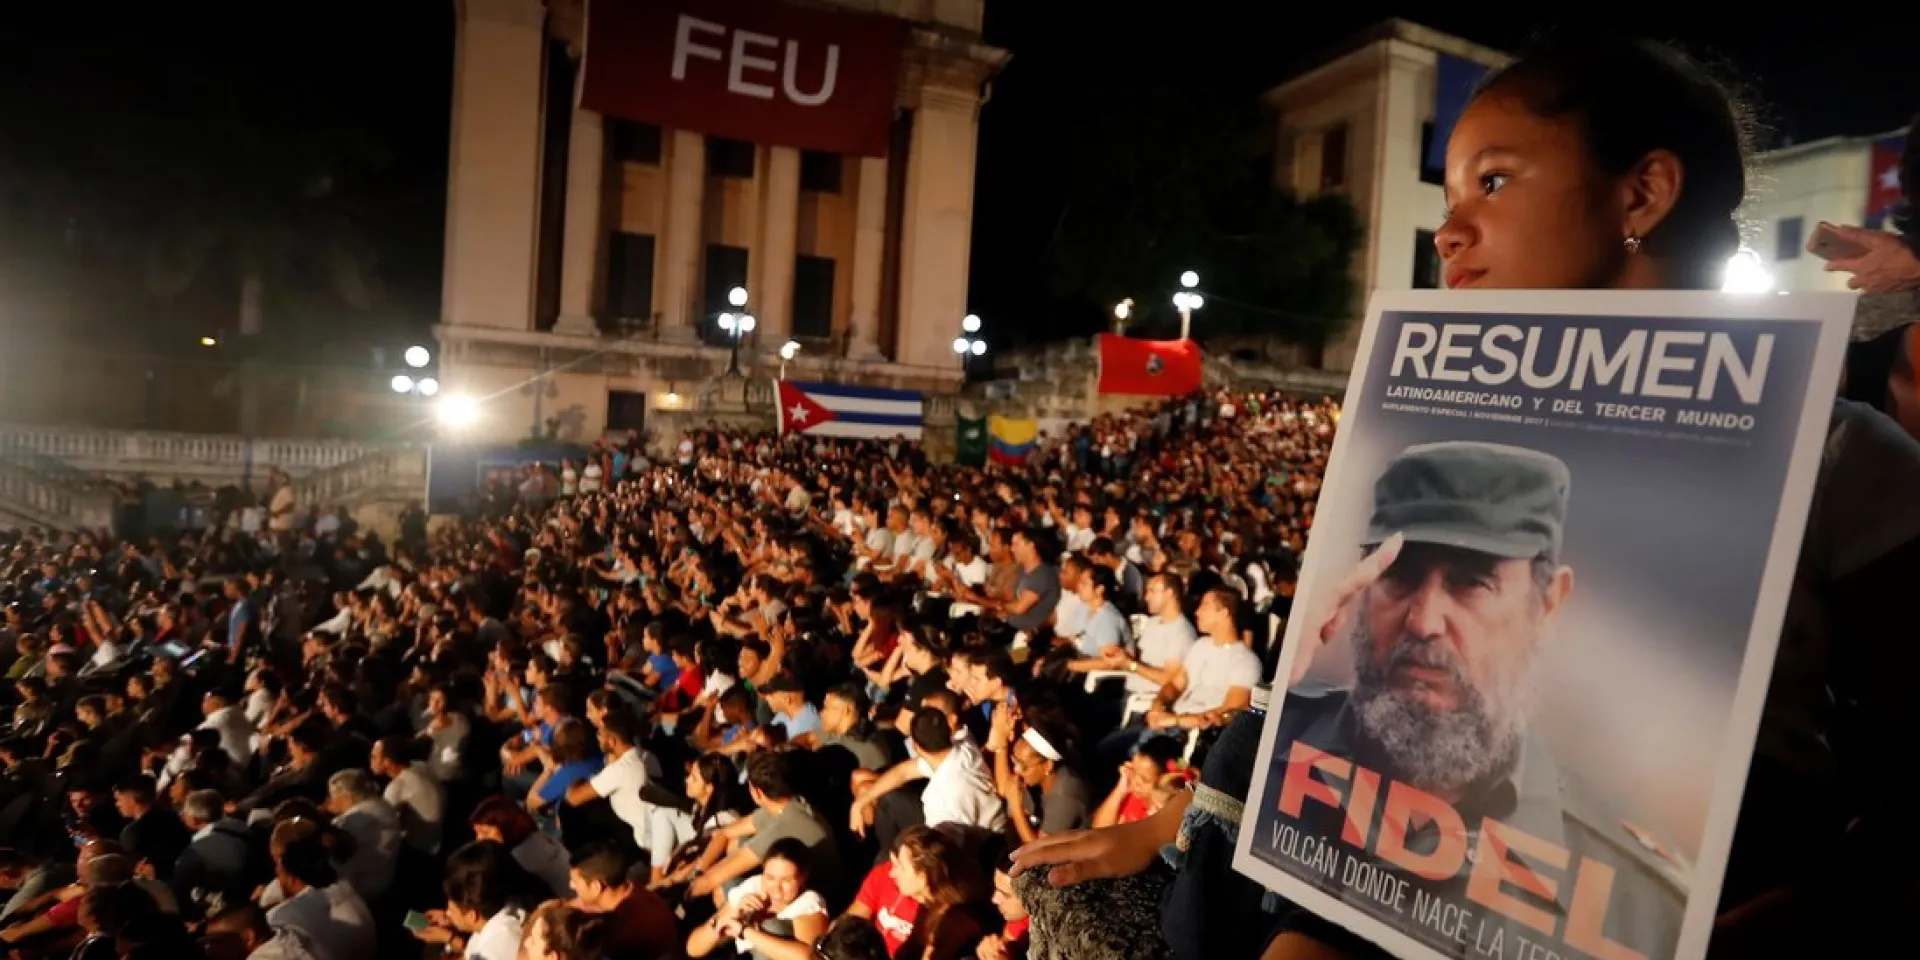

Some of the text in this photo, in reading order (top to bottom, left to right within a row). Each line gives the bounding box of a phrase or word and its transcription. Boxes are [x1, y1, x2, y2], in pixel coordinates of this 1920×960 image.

[671, 12, 840, 106] FEU
[1386, 385, 1755, 431] LATINOAMERICANO Y DEL TERCER MUNDO
[1389, 321, 1776, 404] RESUMEN
[1271, 819, 1339, 878] VOLCÁN
[1342, 859, 1410, 914] DONDE
[1412, 888, 1472, 945] NACE
[1475, 918, 1505, 957] LA
[1278, 739, 1650, 960] FIDEL
